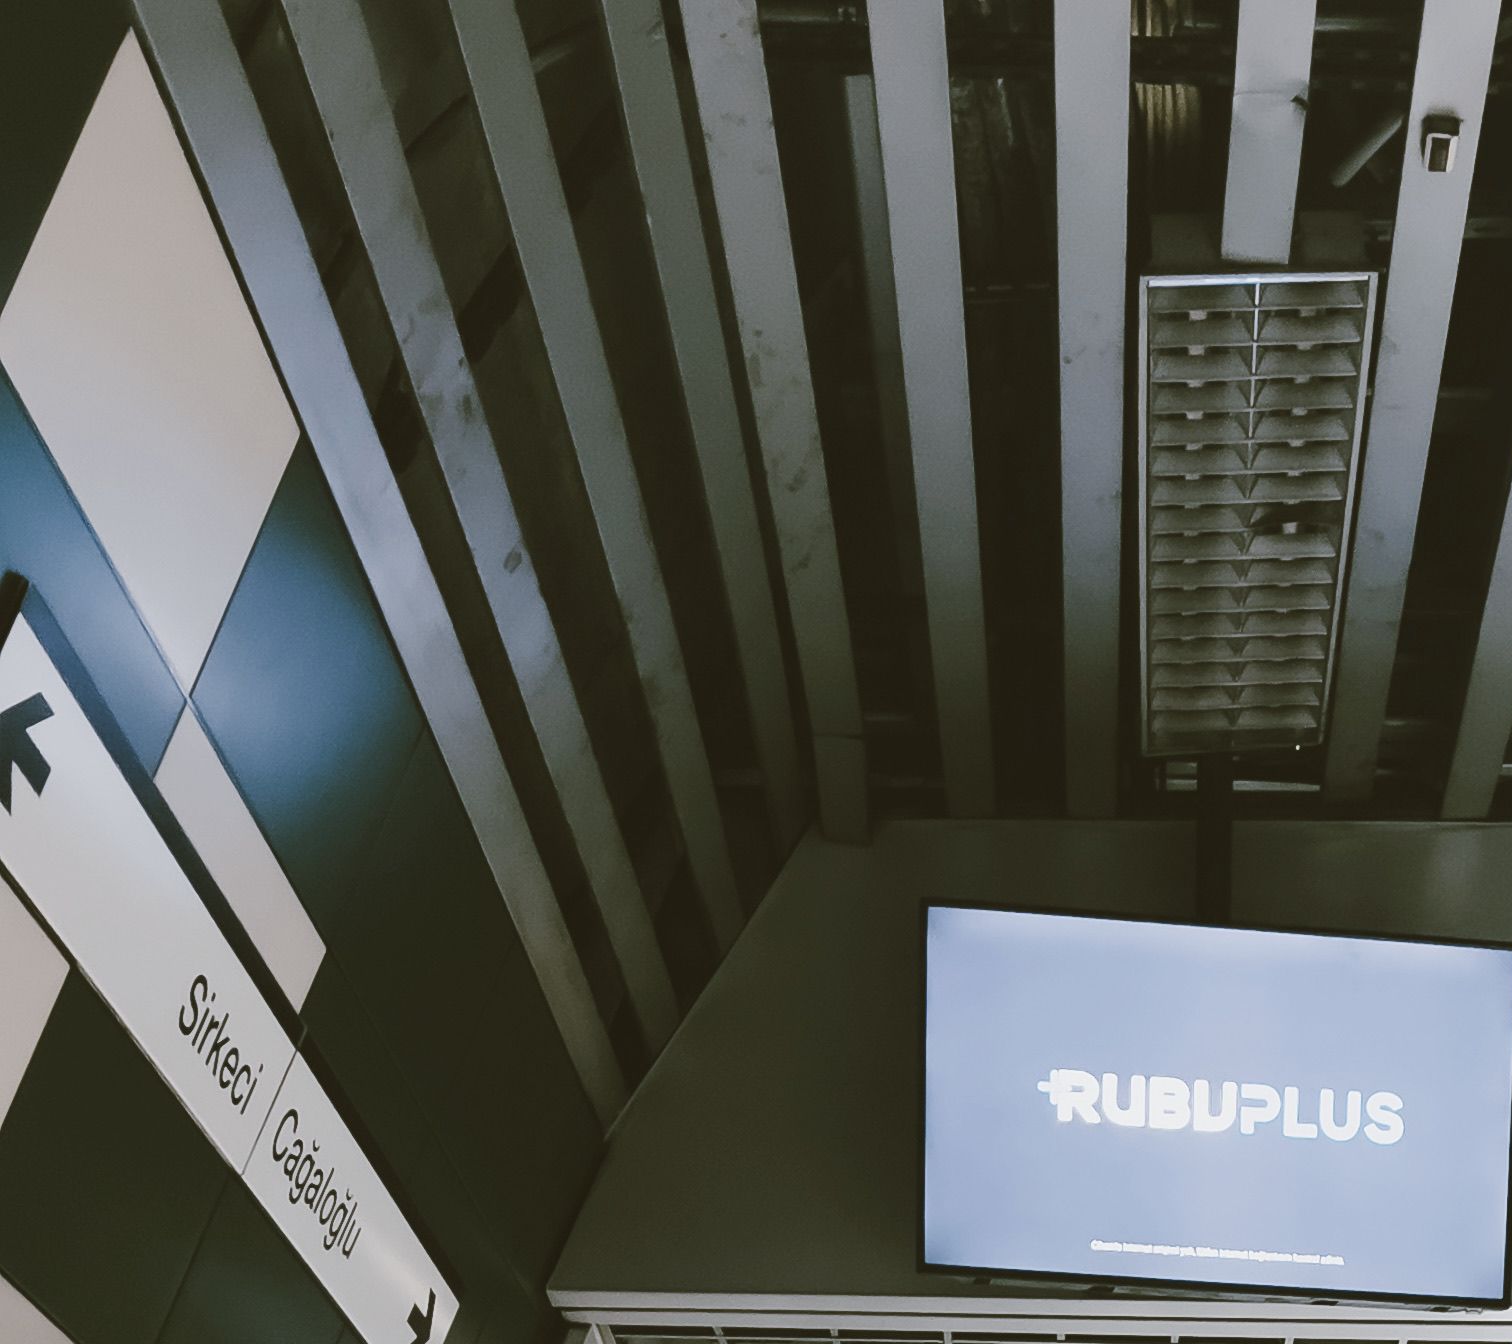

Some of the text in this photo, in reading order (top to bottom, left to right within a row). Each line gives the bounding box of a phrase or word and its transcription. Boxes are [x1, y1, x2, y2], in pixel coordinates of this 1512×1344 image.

[178, 974, 263, 1115] Sirkeci
[1038, 1068, 1405, 1145] RUBUPLUS
[272, 1108, 362, 1260] Cağaloğlu
